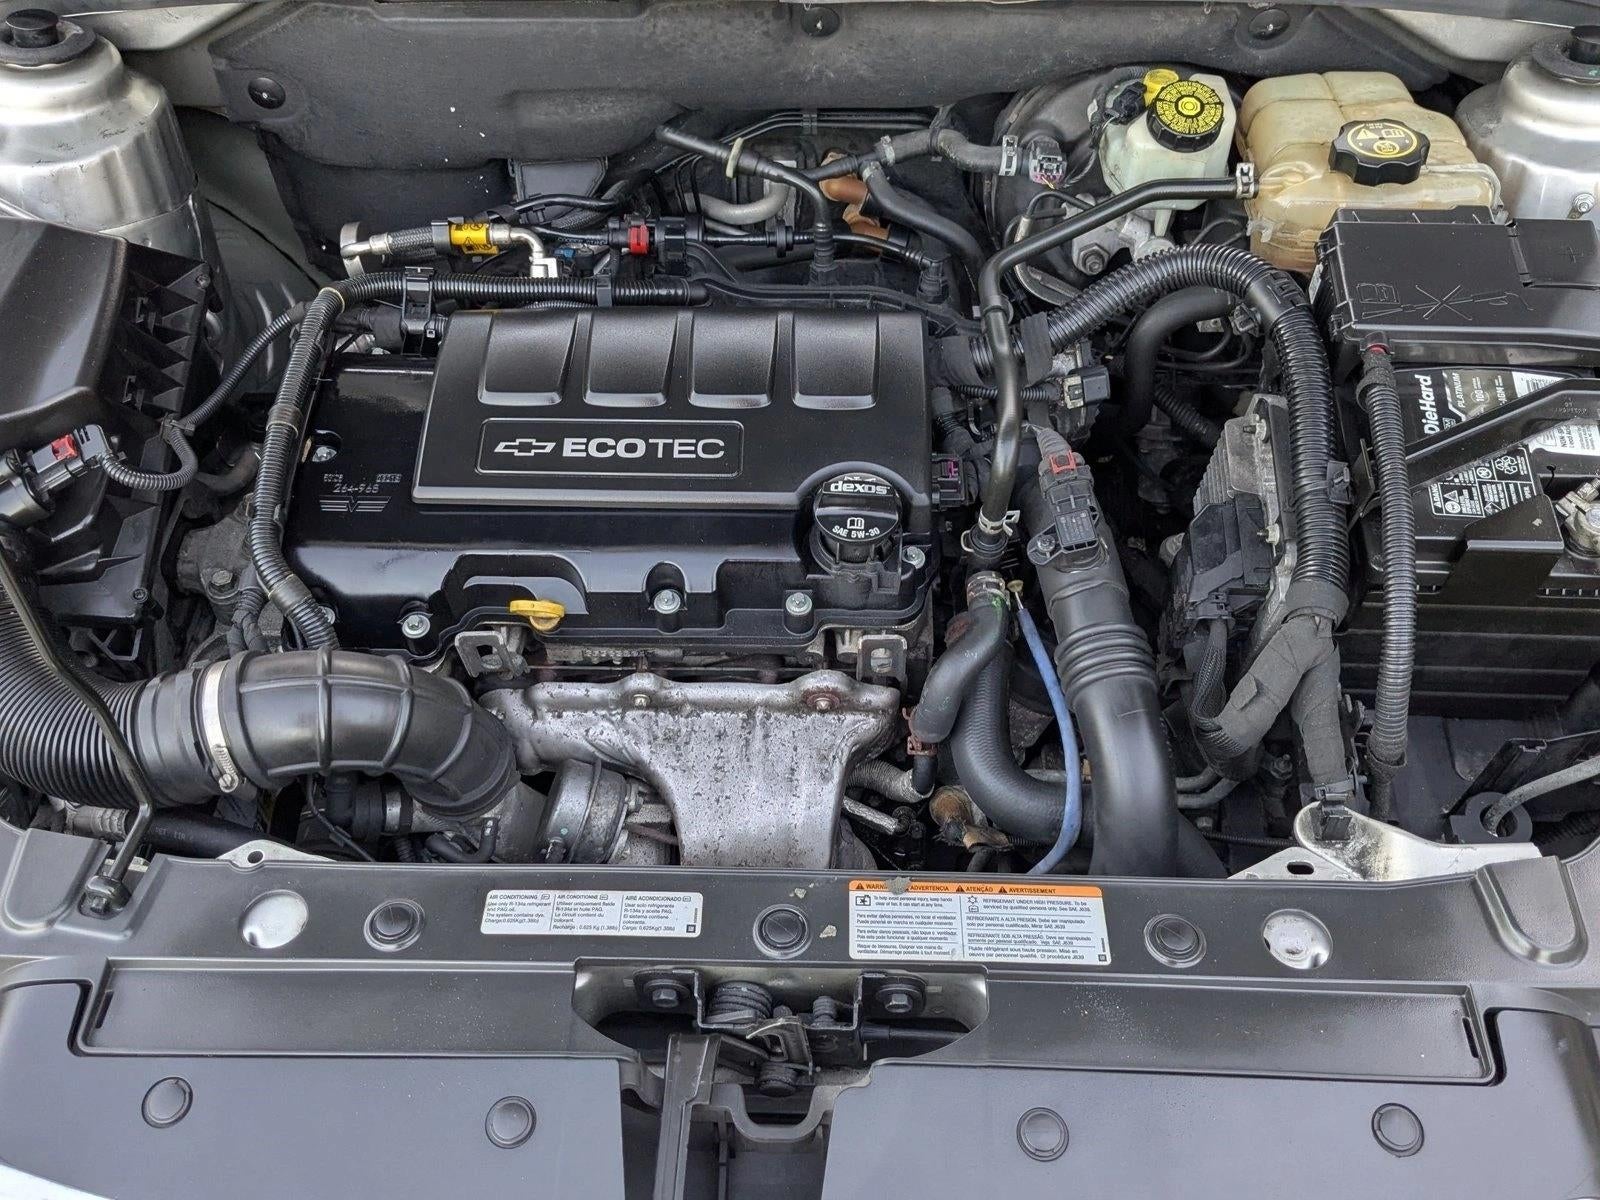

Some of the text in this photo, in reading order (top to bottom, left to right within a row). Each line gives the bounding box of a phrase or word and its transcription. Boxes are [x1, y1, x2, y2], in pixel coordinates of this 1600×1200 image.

[1452, 372, 1466, 408] PLATINUM
[1414, 374, 1440, 434] DieHard
[562, 437, 725, 459] ECOTEC
[830, 481, 888, 495] dexos
[832, 525, 880, 539] SAE 5W-30
